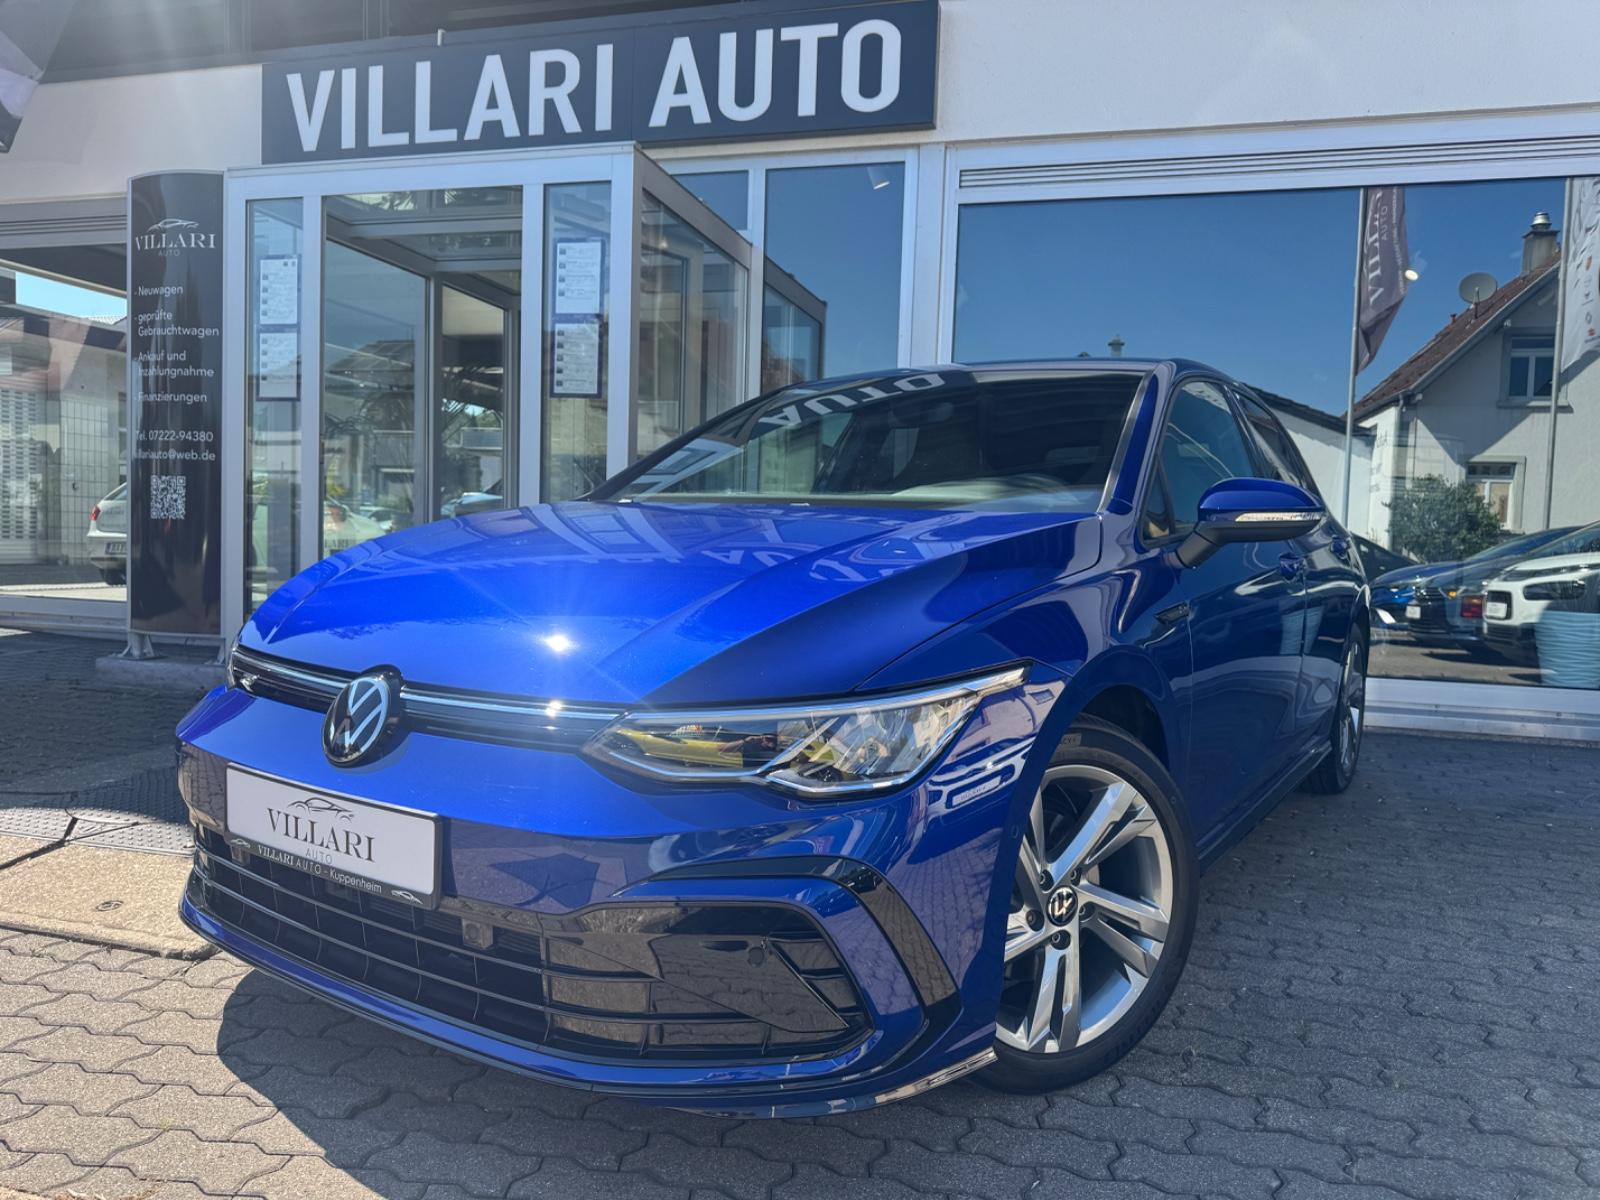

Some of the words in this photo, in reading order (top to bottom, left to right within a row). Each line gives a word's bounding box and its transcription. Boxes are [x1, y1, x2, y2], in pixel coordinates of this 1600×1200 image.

[286, 43, 613, 152] VILLARI
[648, 19, 902, 127] AUTO
[135, 233, 216, 251] VILLARI
[138, 286, 184, 297] Neuwagen
[138, 309, 173, 324] geprüfte
[138, 324, 220, 339] Gebrauchtwagen
[167, 350, 187, 361] und
[148, 430, 214, 442] 07222-94380
[267, 807, 375, 864] VILLARI
[305, 847, 333, 865] AUTO
[258, 845, 294, 867] VILLARI
[296, 857, 322, 876] AUTO
[330, 868, 383, 894] Kuppenheim
